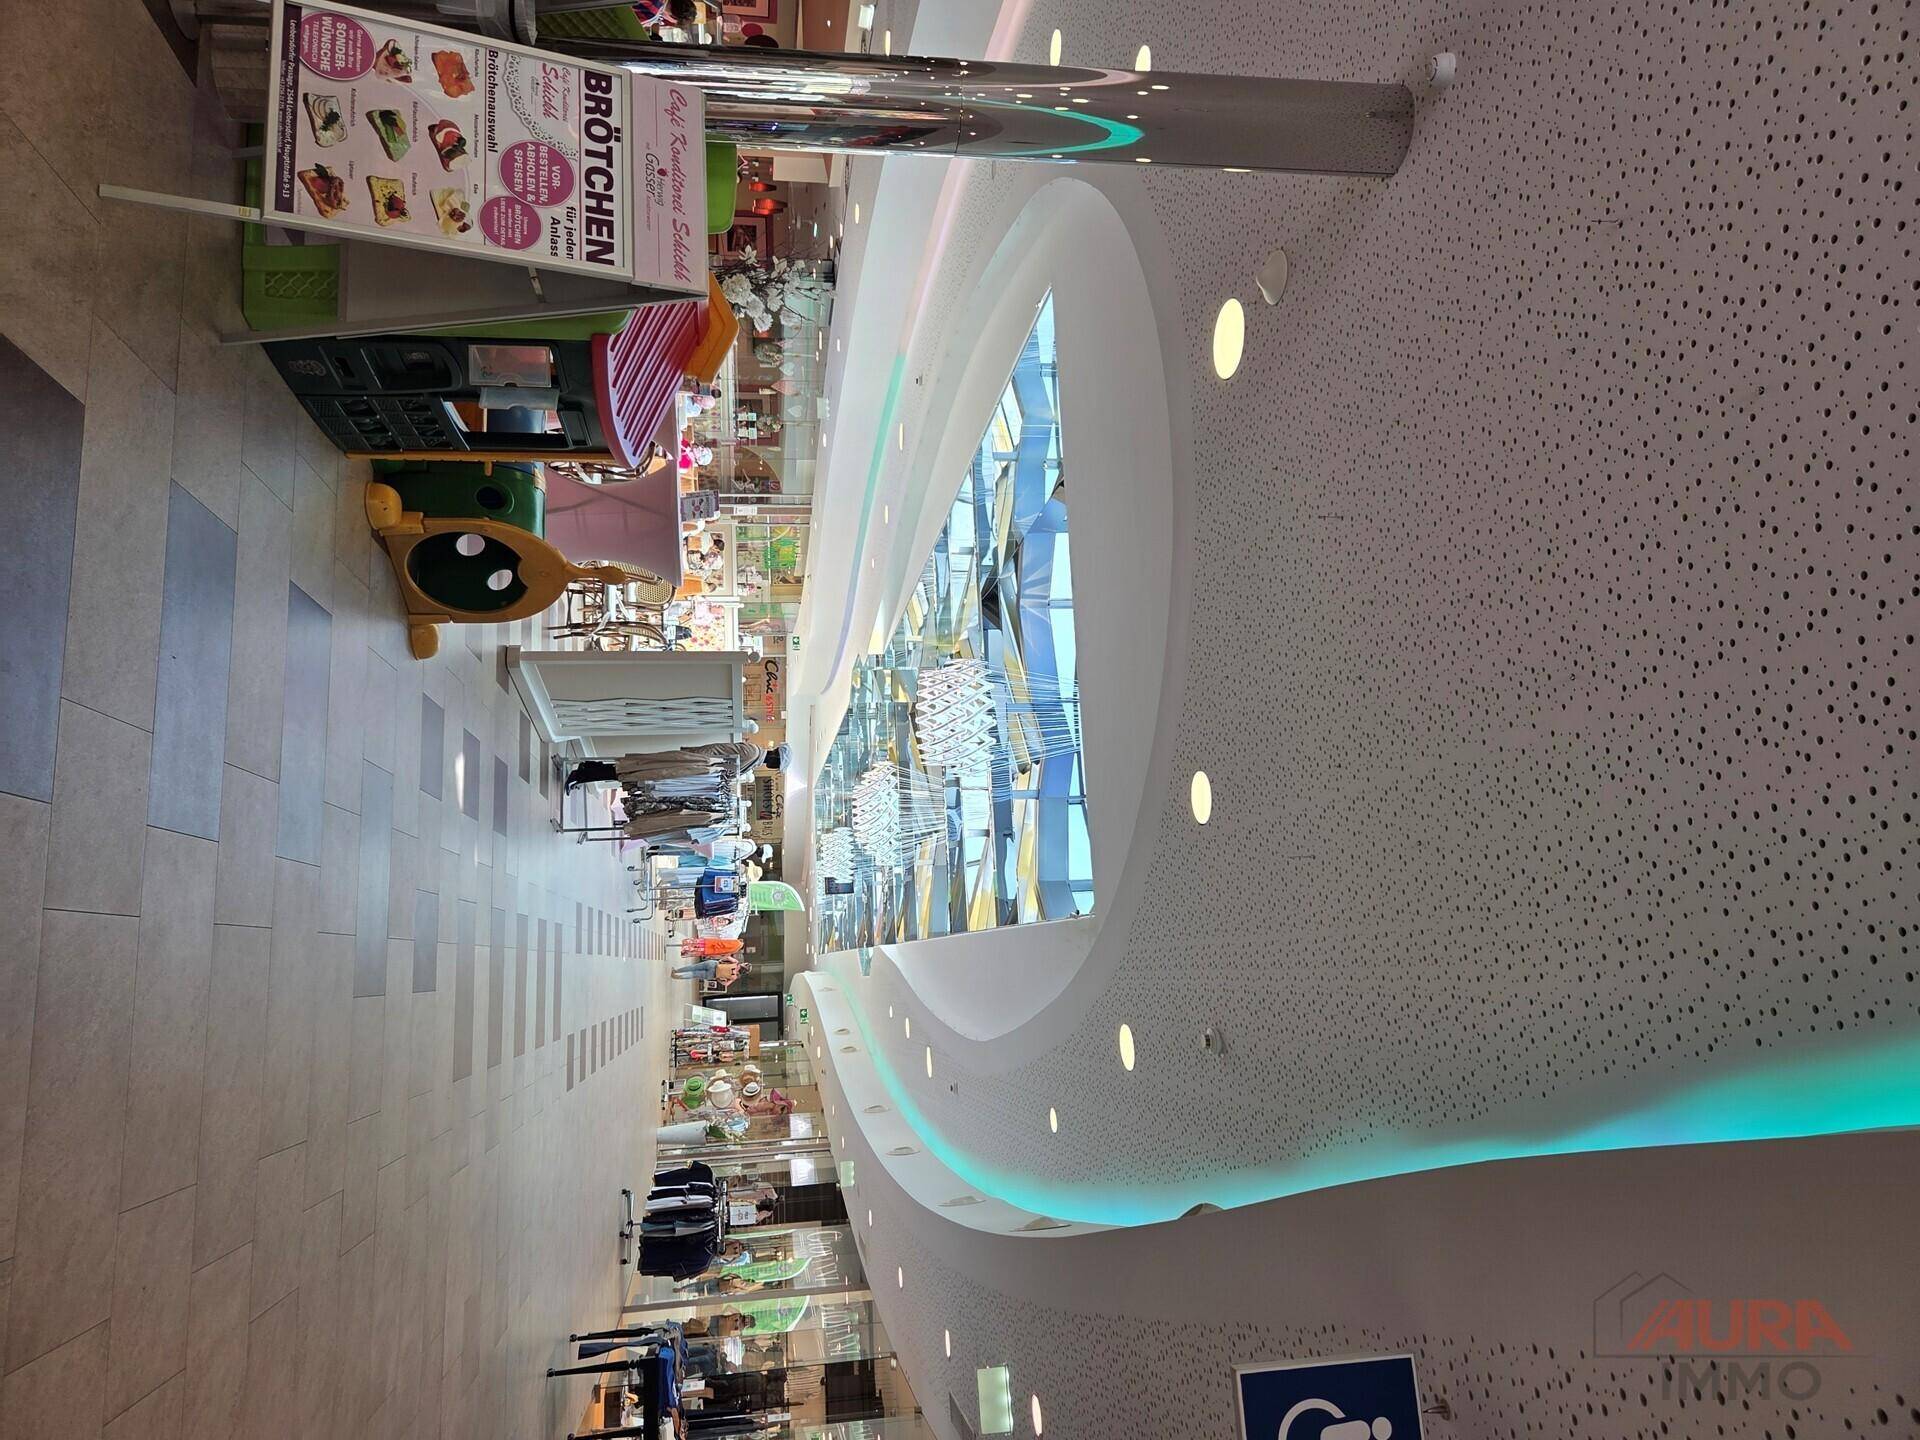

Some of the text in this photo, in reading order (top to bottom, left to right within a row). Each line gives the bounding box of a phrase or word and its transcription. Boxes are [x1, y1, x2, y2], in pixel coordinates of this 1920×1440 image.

[311, 21, 319, 62] TELEFONISCH
[320, 16, 334, 72] WÜNSCHE
[335, 22, 346, 71] SONDER-
[282, 20, 297, 198] Leobersdorfer Passage, 2544 Leobersdorf, Hauptstraße 9-13
[487, 50, 498, 153] Brötchenauswahl
[542, 63, 559, 120] Schickh
[514, 149, 523, 192] SPEISEN
[526, 143, 536, 202] ABHOLEN &
[538, 146, 548, 204] BESTELLEN,
[552, 166, 560, 190] VOR-
[584, 70, 621, 266] BRÖTCHEN
[645, 153, 659, 198] Gasser
[655, 176, 666, 207] Herwig
[664, 88, 692, 284] Café Konditorei Schickh
[514, 204, 522, 244] BRÖTCHEN
[550, 216, 561, 257] Anlass
[564, 206, 576, 260] für jeden
[765, 660, 779, 694] Chic
